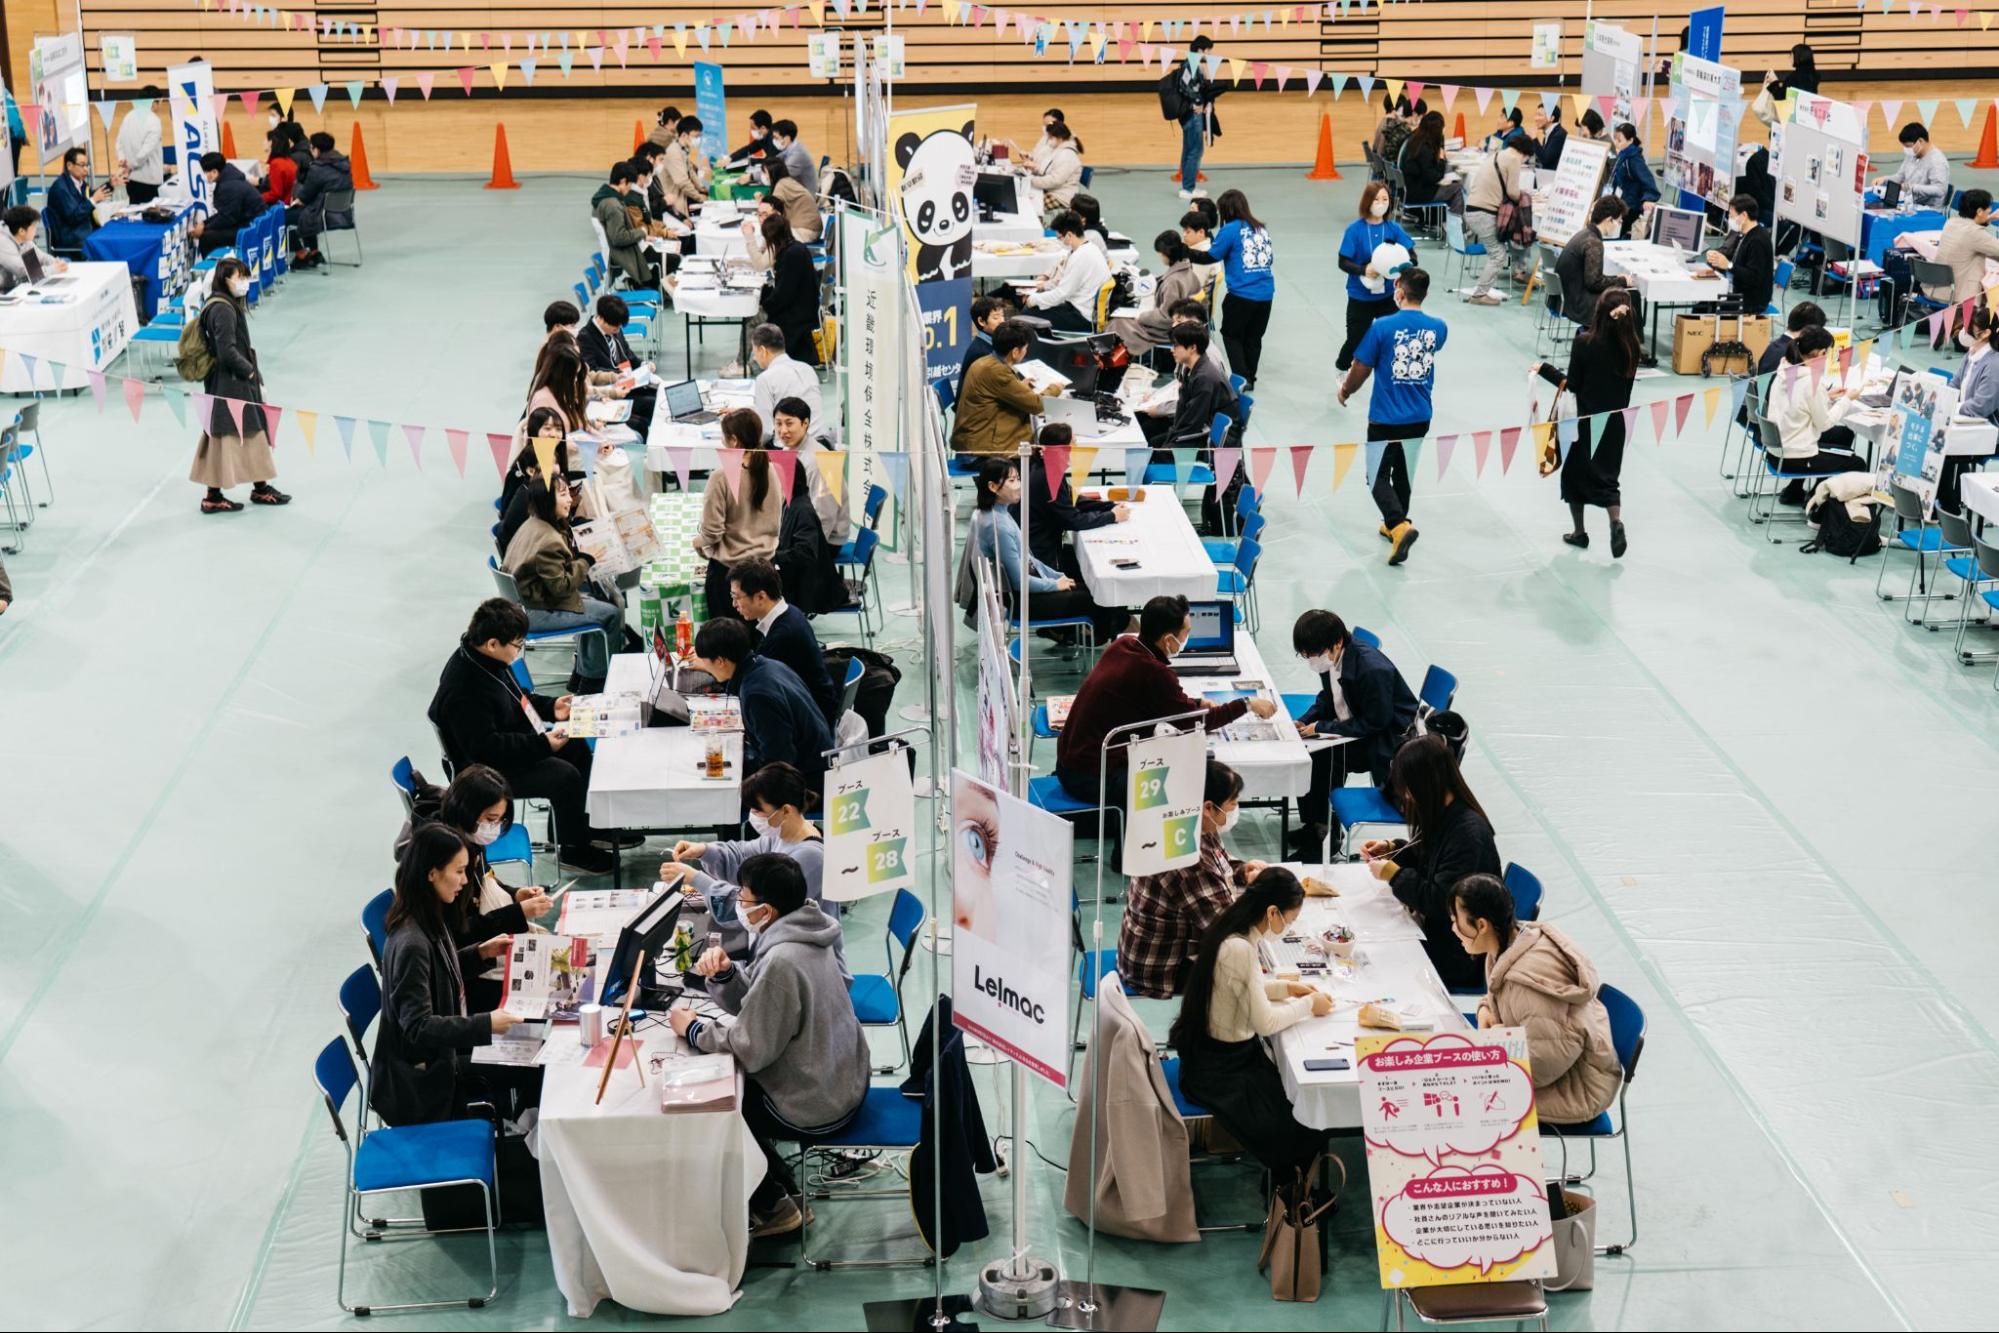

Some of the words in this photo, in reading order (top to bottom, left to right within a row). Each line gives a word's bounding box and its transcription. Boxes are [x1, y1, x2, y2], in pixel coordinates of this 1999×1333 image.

[862, 288, 878, 497] 近畿環境保全株式会
[1140, 758, 1164, 770] ブース
[838, 780, 863, 794] ブース
[1140, 779, 1161, 799] 29
[838, 802, 860, 824] 22
[873, 829, 901, 842] ブース
[1174, 828, 1187, 846] C
[874, 850, 898, 871] 28
[1375, 1049, 1500, 1067] お楽しみ企業ブースの使い方
